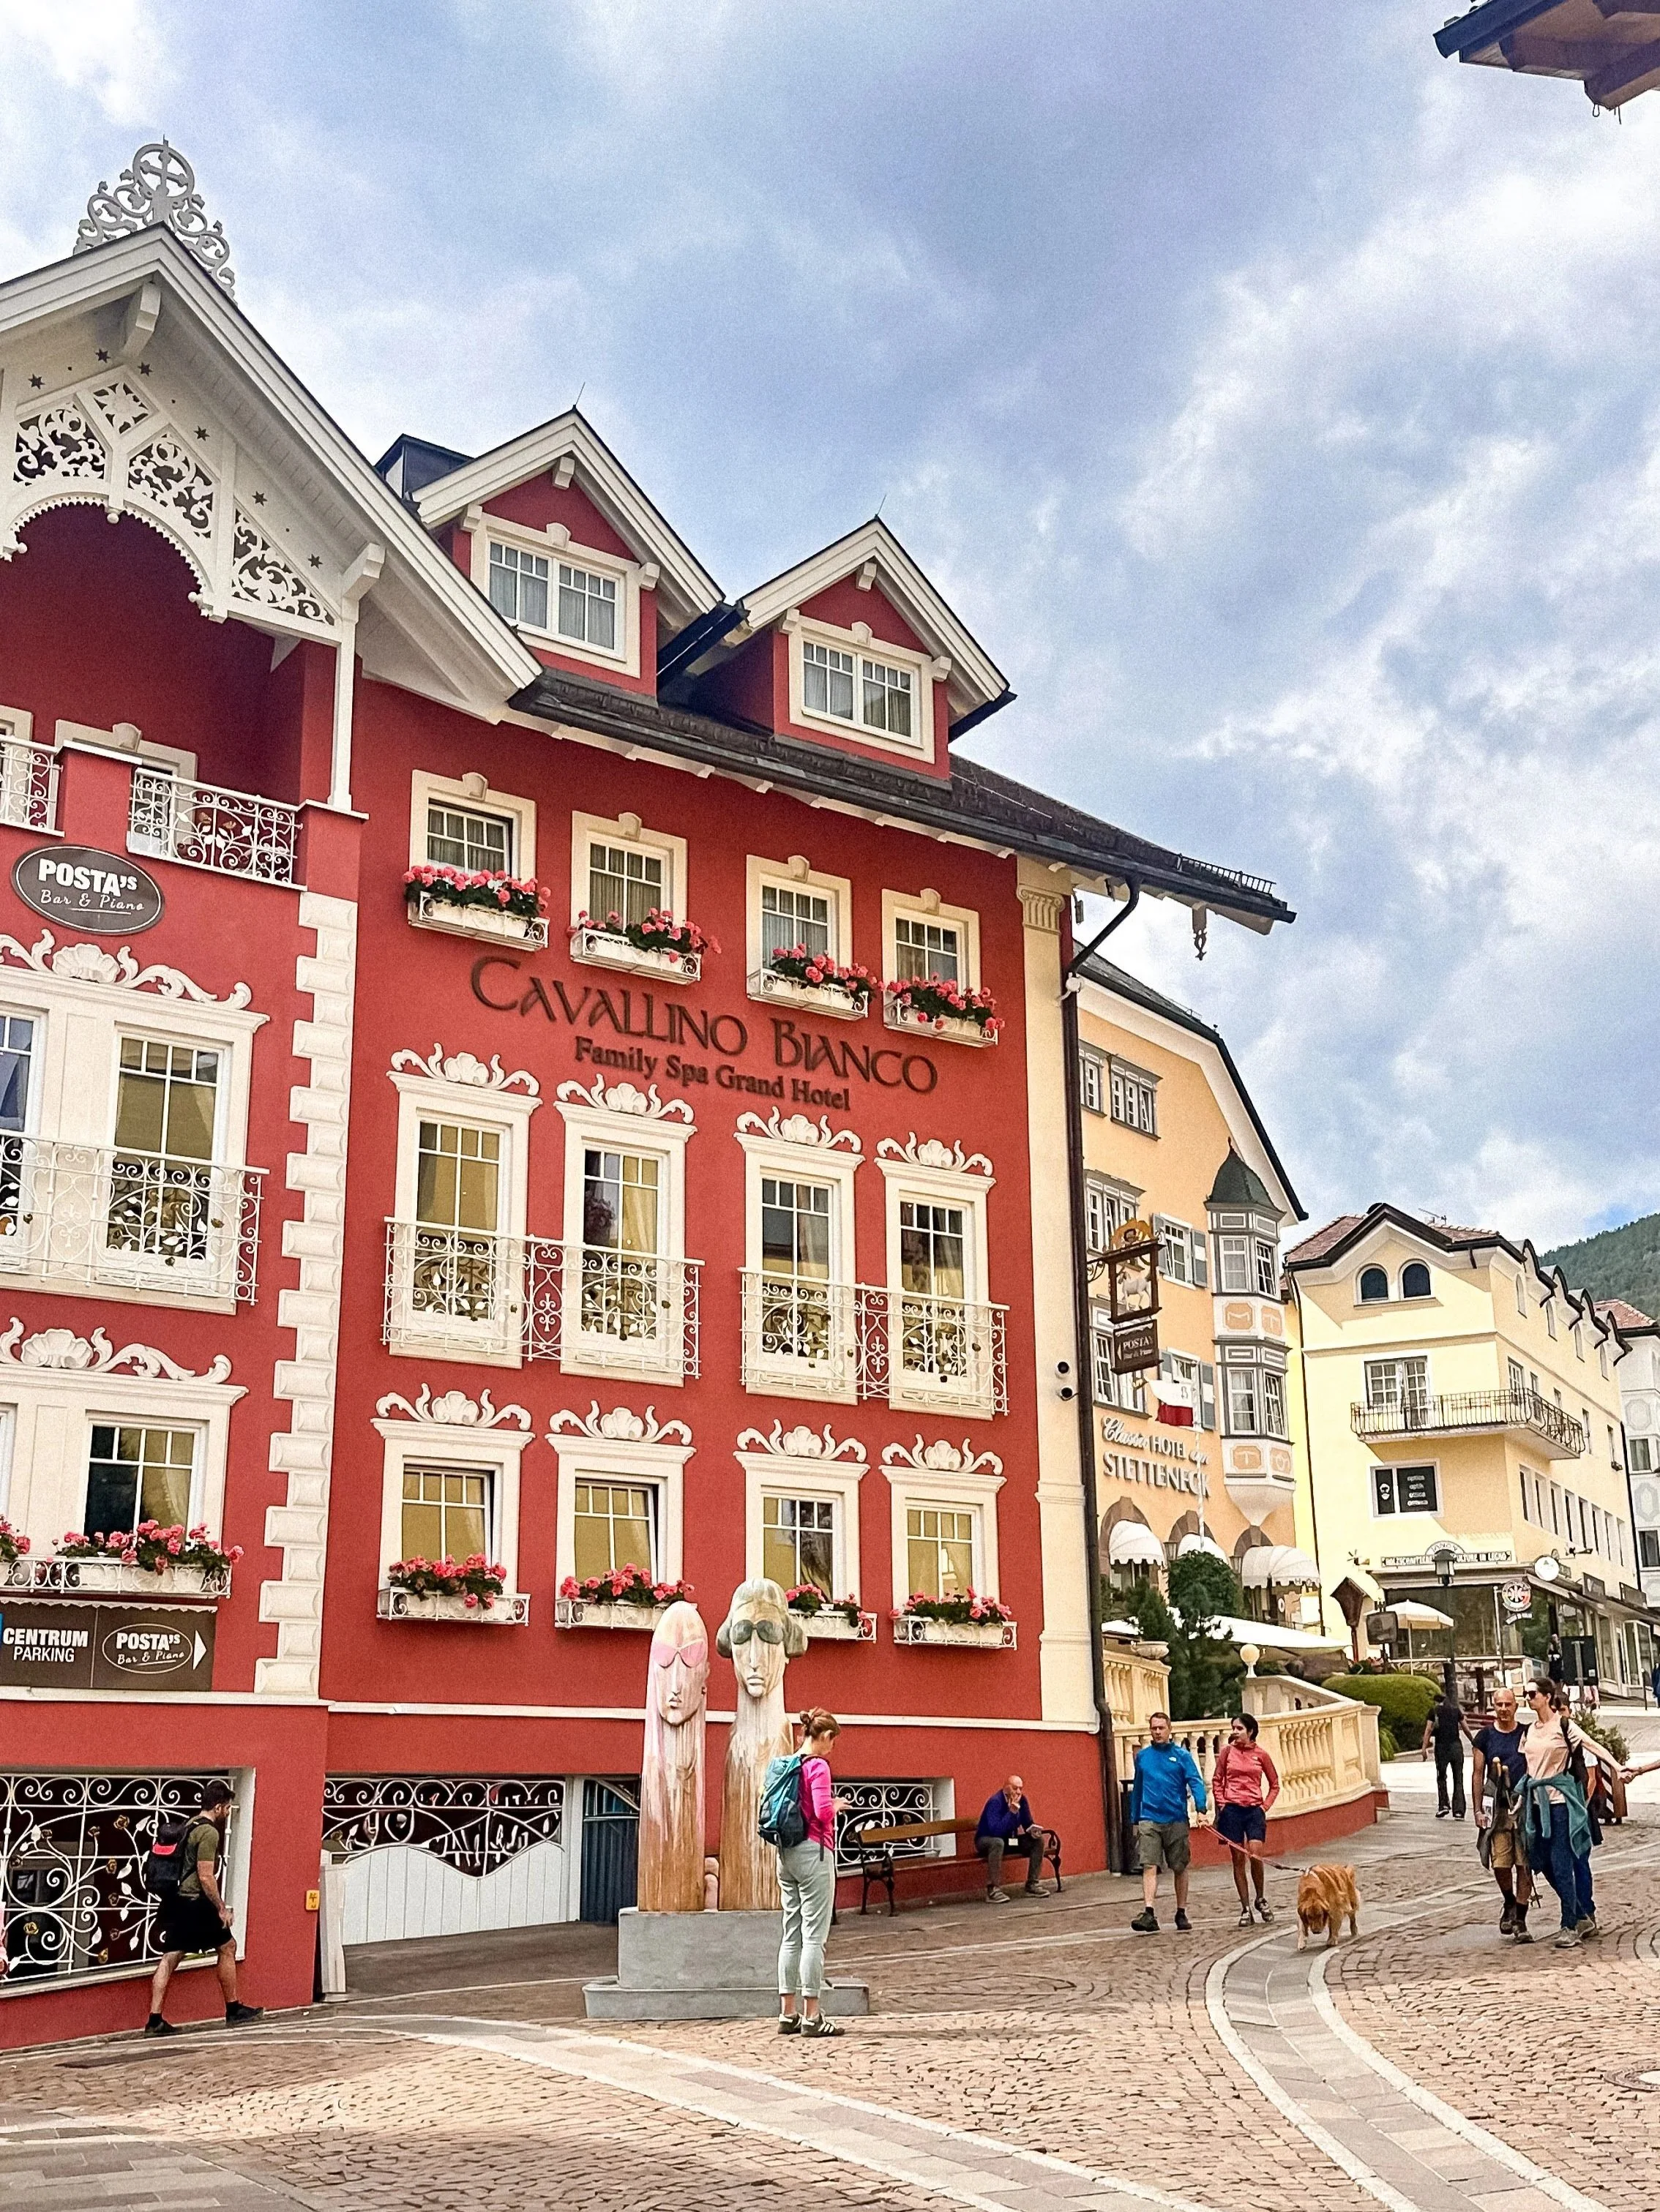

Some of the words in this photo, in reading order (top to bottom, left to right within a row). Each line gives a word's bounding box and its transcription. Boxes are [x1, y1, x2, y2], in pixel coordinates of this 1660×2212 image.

[40, 890, 71, 905] Bar
[79, 893, 91, 907] &
[100, 894, 145, 910] Piano
[471, 955, 748, 1056] CAVALLINO
[770, 1017, 938, 1093] BIANCO
[575, 1036, 657, 1078] Family
[665, 1054, 709, 1087] Spa
[715, 1064, 785, 1099] Grand
[791, 1077, 850, 1111] Hotel
[1151, 1436, 1186, 1459] HOTEL
[3, 1627, 89, 1647] CENTRUM
[13, 1646, 75, 1662] PARKING
[117, 1654, 138, 1665] Bar
[142, 1651, 151, 1662] &
[155, 1650, 184, 1660] Piano
